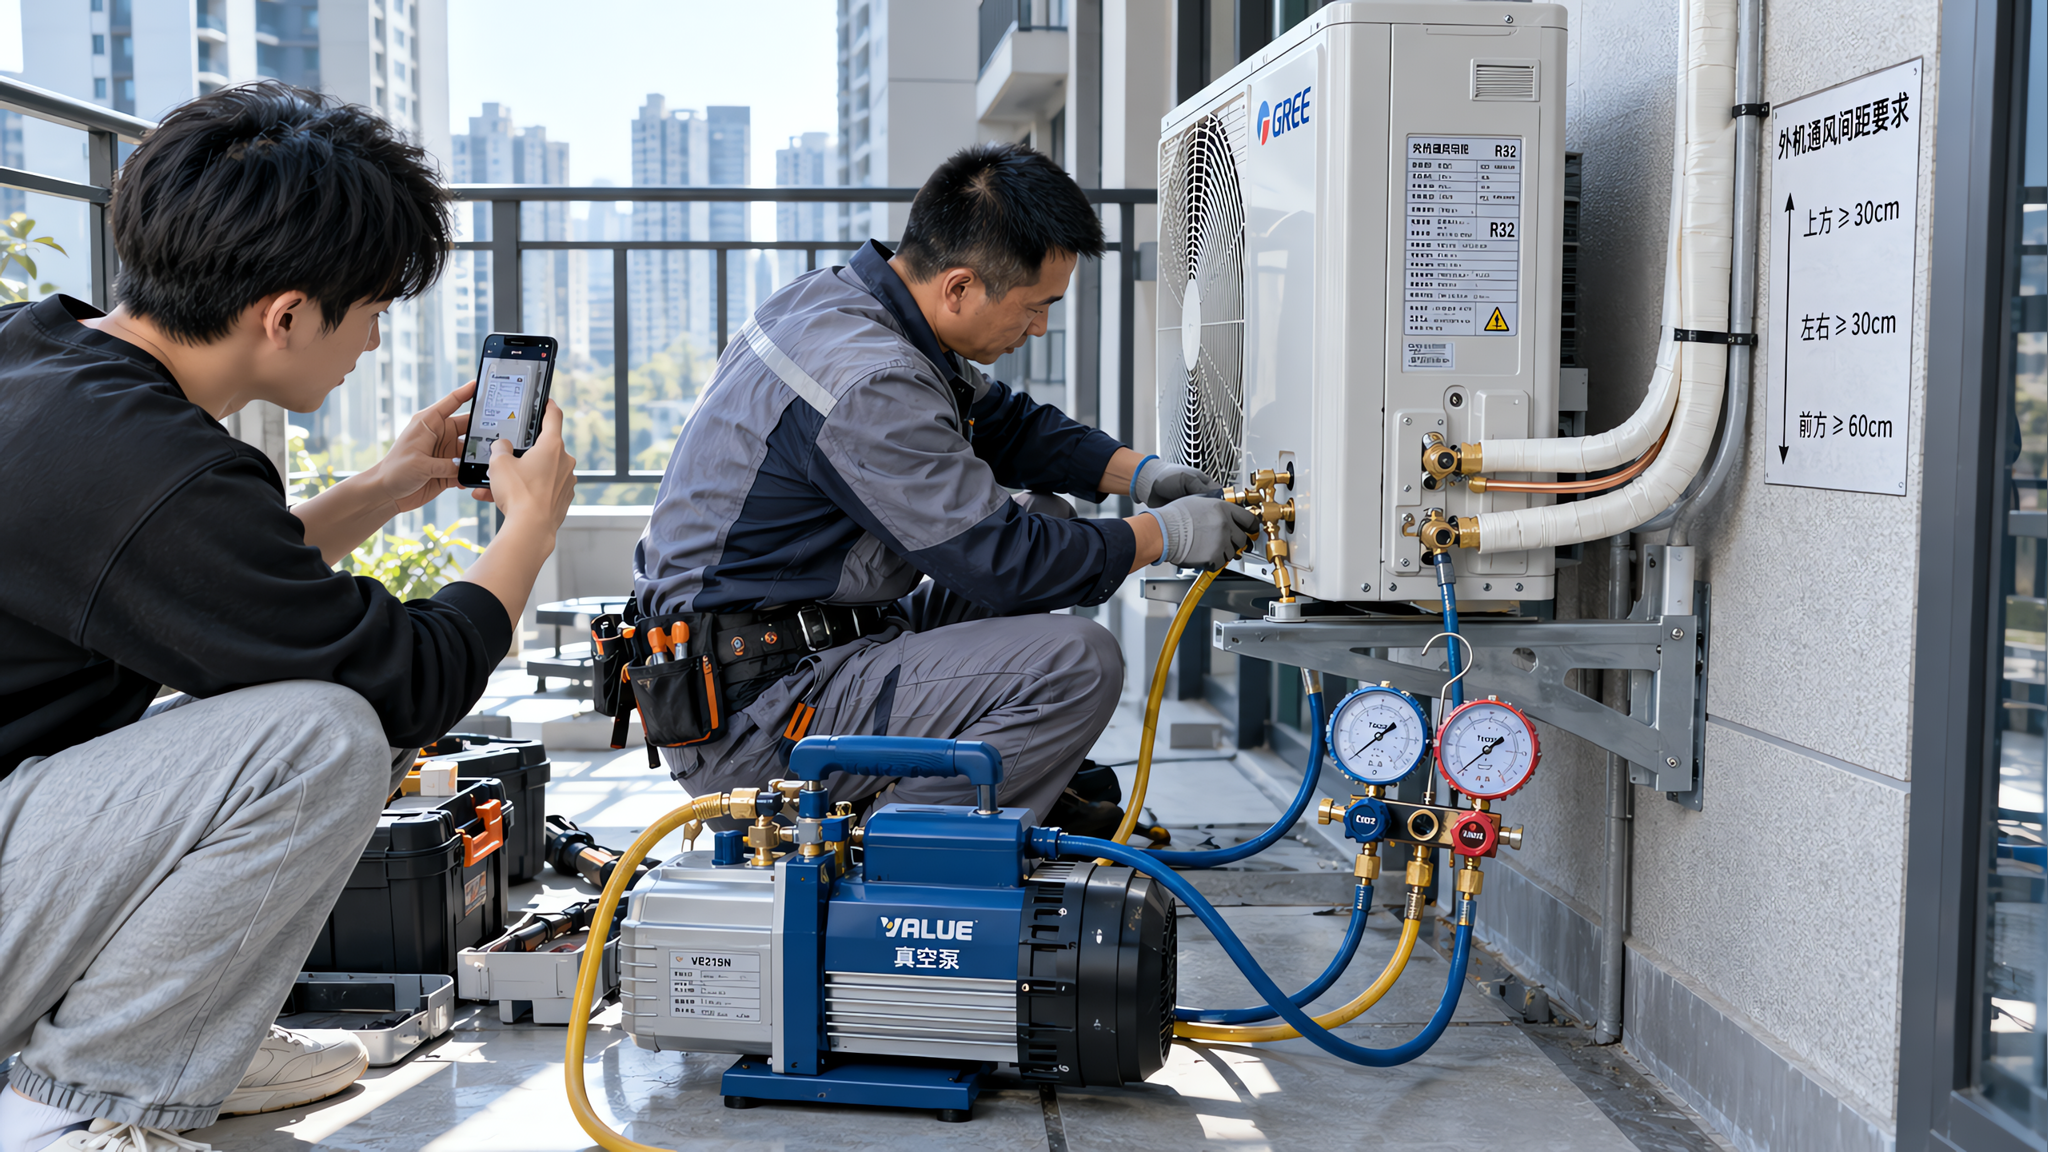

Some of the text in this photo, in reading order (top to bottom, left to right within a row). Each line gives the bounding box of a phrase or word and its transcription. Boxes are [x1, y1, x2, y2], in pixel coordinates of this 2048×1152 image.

[1272, 86, 1311, 138] GREE
[1778, 91, 1909, 160] 外机通风间距要求
[1494, 144, 1517, 158] R32
[1489, 221, 1515, 238] R32
[1803, 206, 1833, 237] 上方
[1854, 200, 1899, 227] 30cm
[1801, 312, 1830, 341] 左右
[1851, 311, 1896, 335] 30cm
[1799, 411, 1827, 438] 前方
[1849, 414, 1893, 438] 60cm
[880, 916, 974, 941] VALUE
[894, 946, 960, 970] 真空泵
